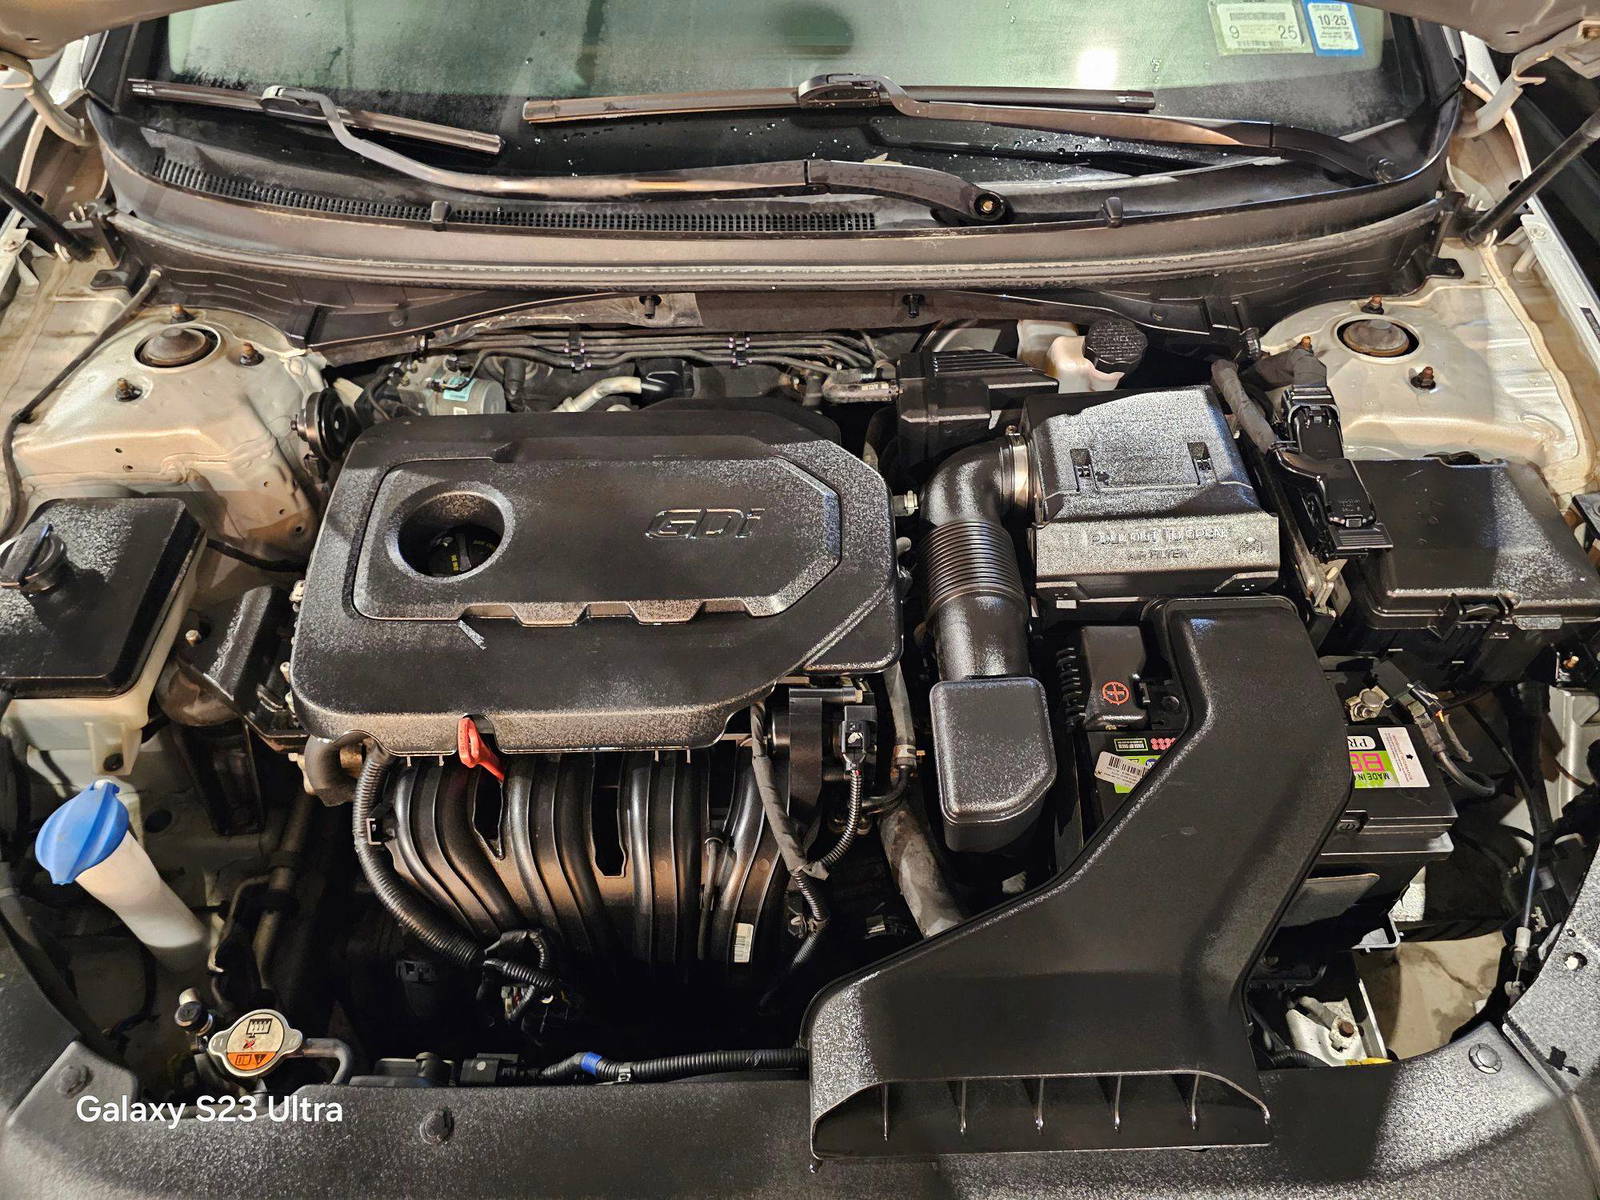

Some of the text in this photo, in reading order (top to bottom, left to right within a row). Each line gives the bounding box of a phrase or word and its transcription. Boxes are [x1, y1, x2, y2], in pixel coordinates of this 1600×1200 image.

[1229, 25, 1240, 40] 9
[1278, 25, 1298, 40] 25
[1149, 548, 1189, 560] FILTER
[1357, 772, 1390, 781] MADE IN
